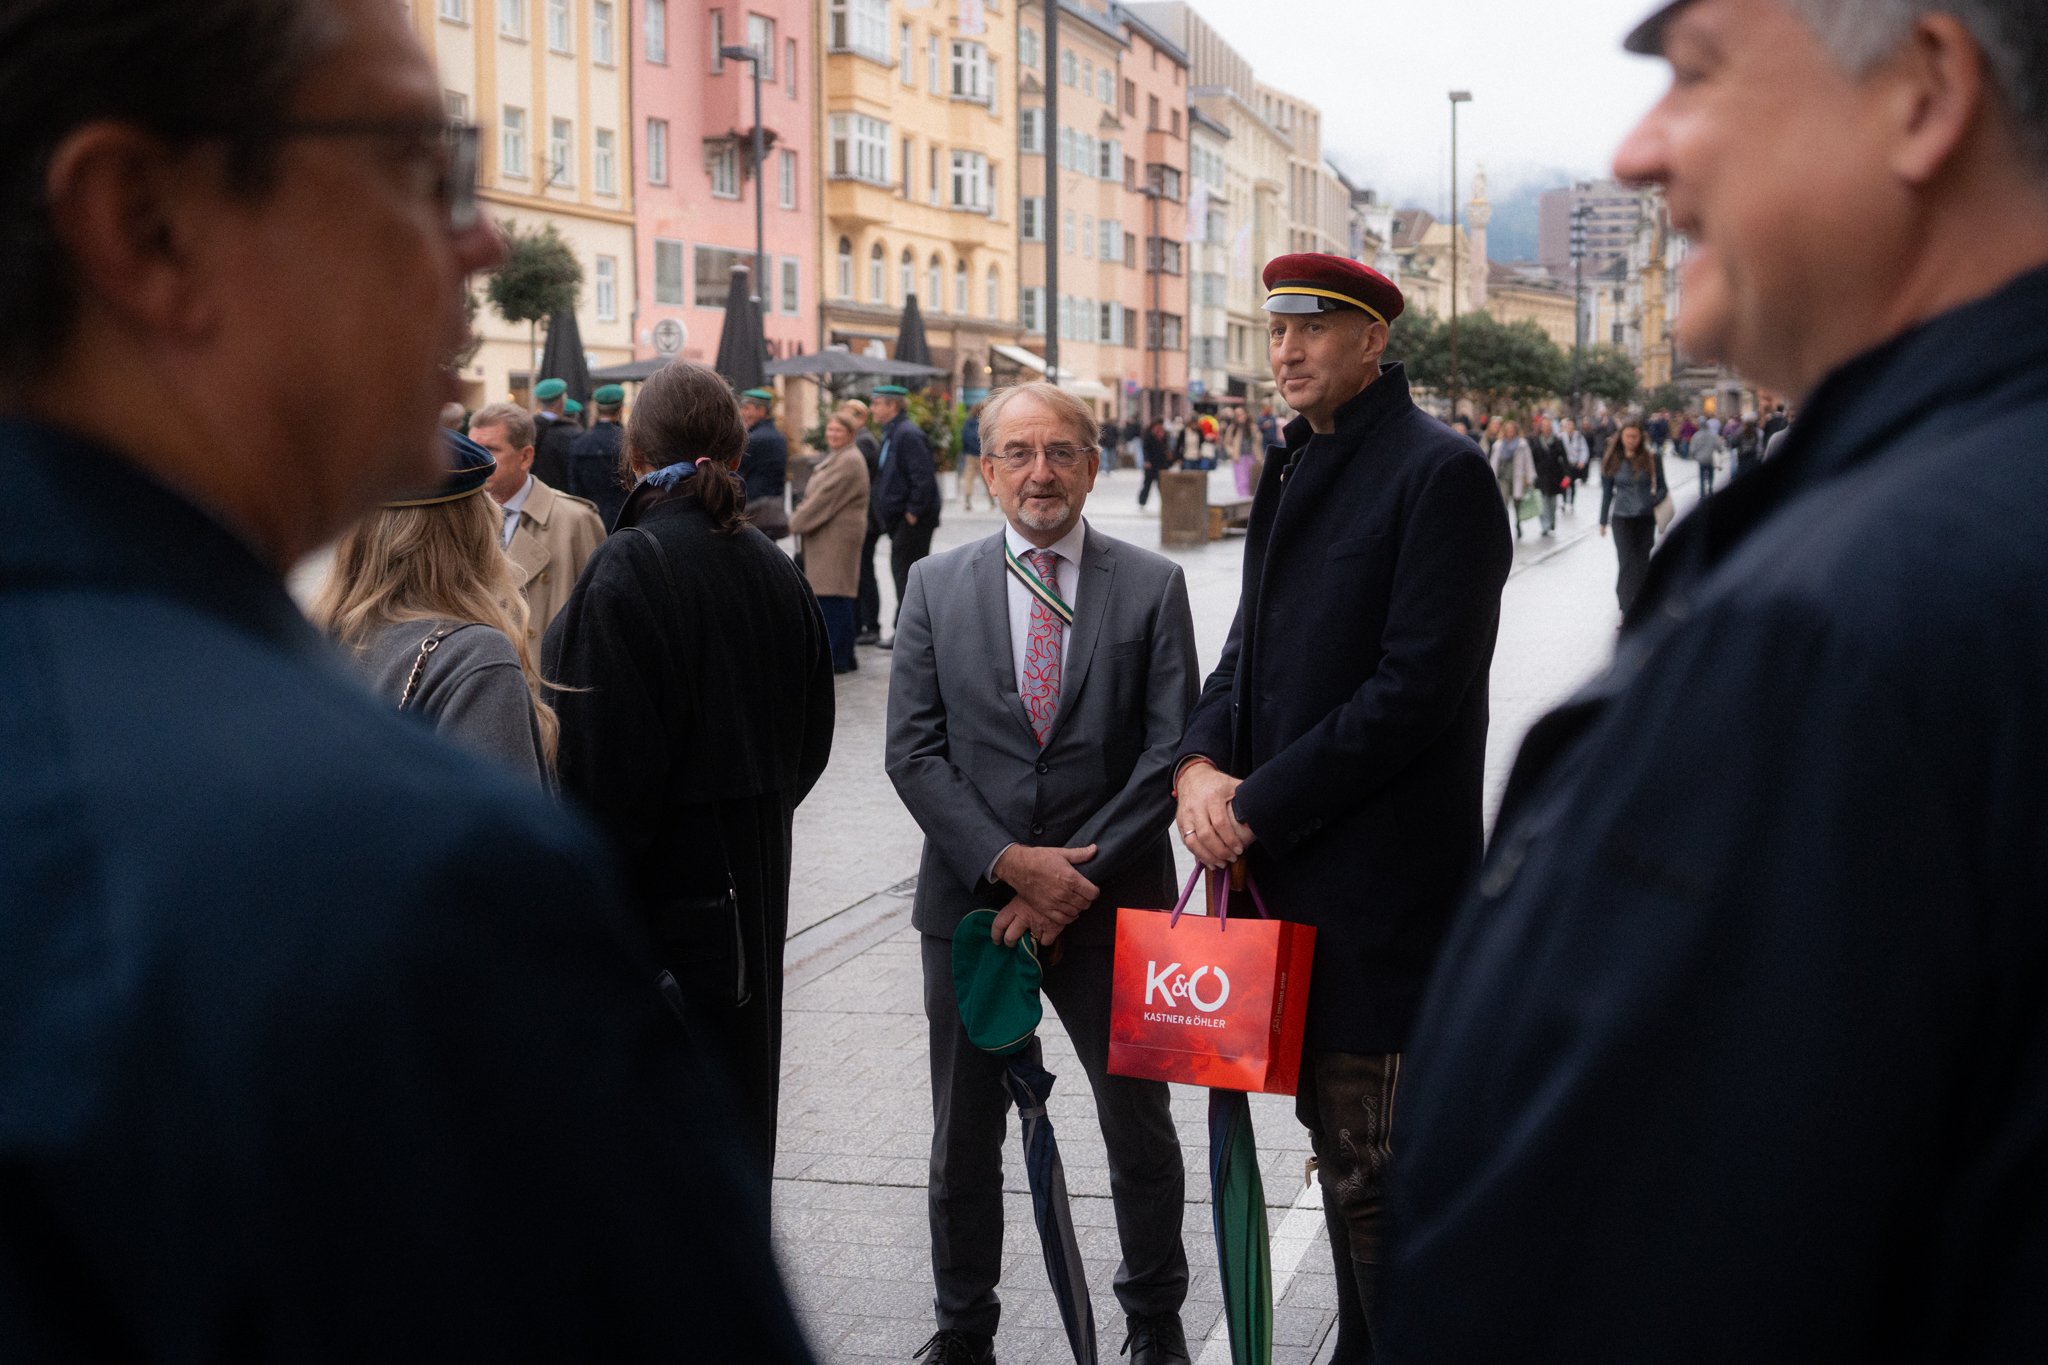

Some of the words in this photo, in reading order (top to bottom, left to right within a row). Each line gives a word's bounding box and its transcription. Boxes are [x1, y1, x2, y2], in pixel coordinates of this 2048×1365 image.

[1144, 1011, 1184, 1025] KASTNER
[1185, 1015, 1193, 1026] &
[1193, 1014, 1226, 1029] ÖHLER
